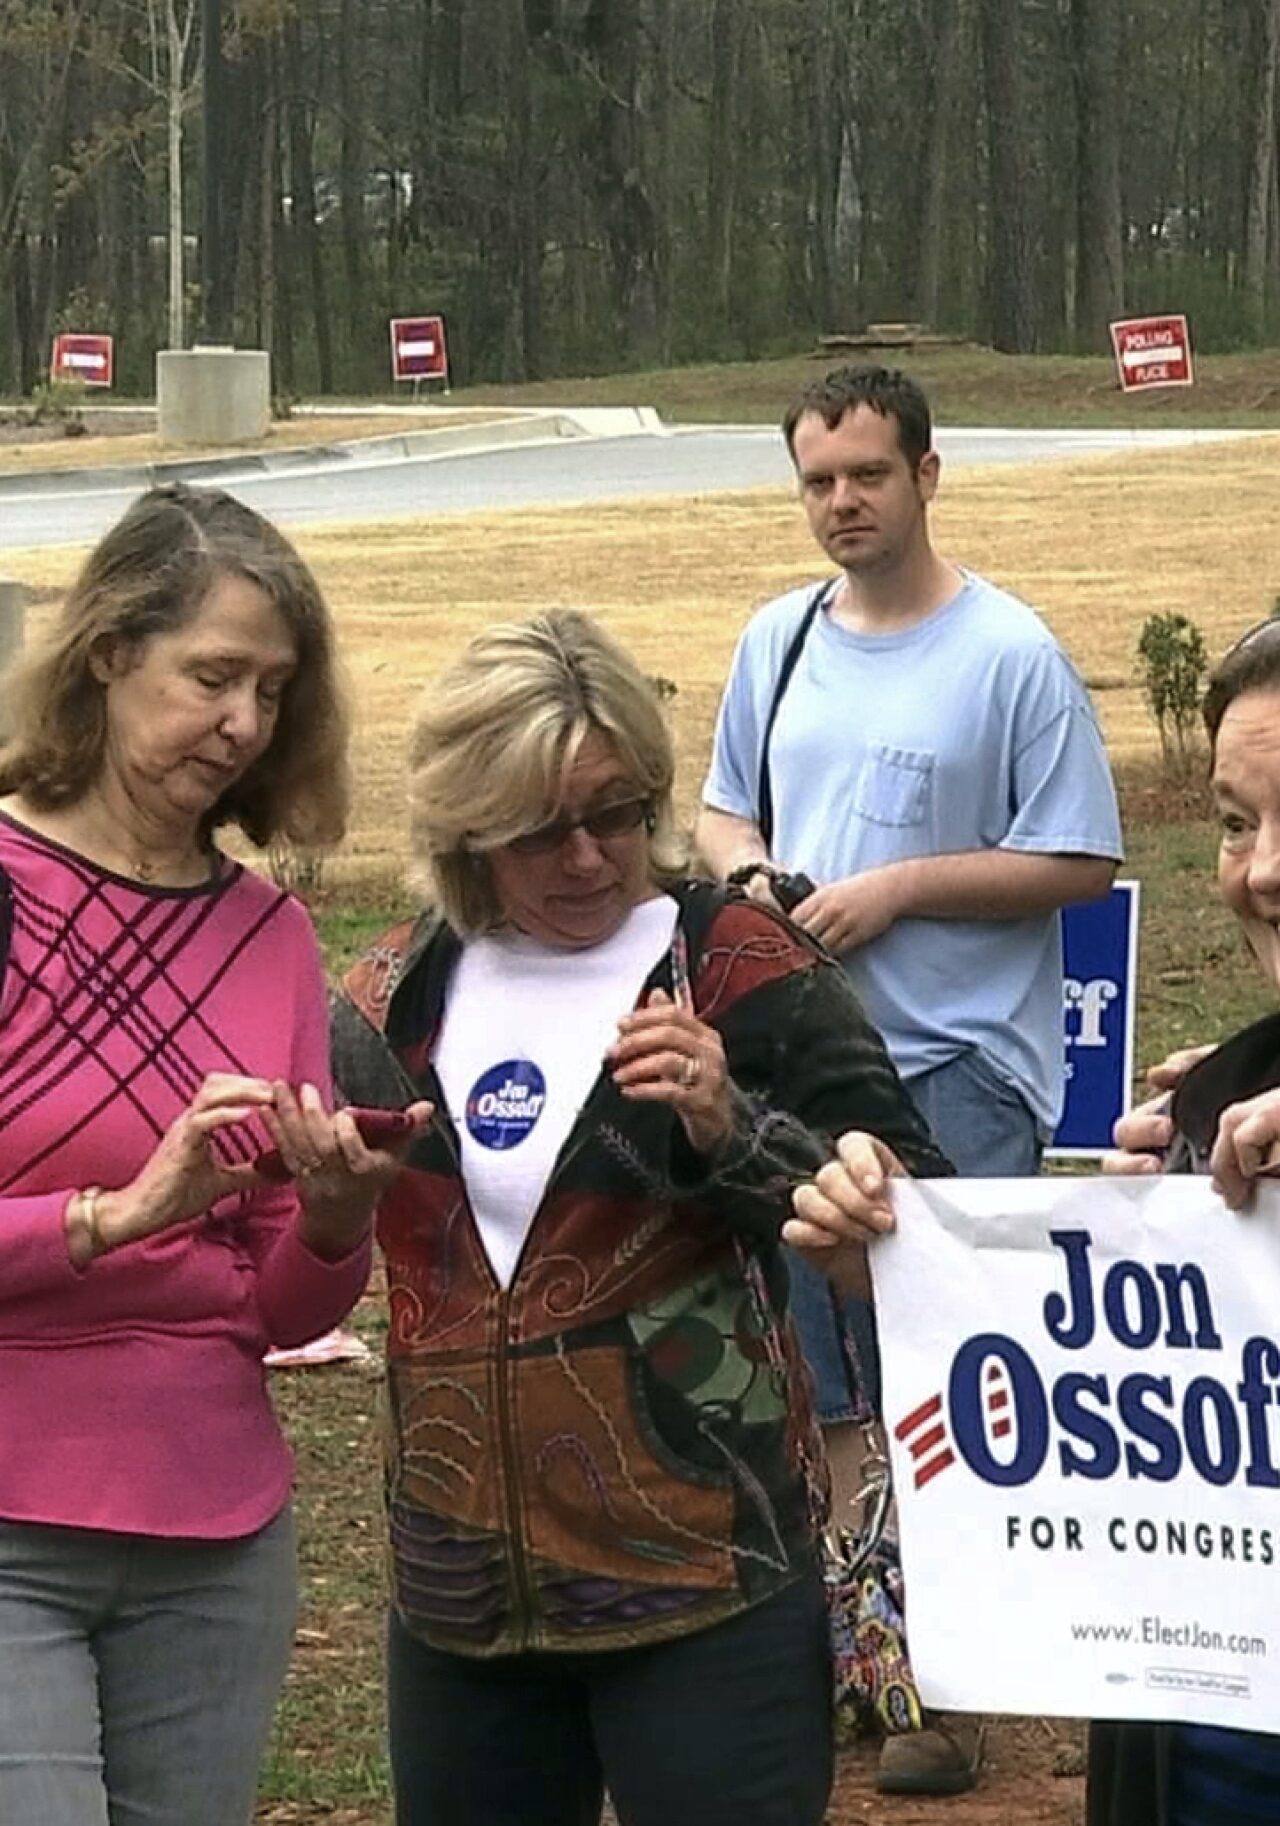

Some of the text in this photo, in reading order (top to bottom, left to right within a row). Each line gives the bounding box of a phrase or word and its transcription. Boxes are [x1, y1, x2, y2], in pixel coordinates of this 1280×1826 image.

[1043, 1229, 1222, 1350] Jon
[1006, 1515, 1084, 1551] FOR
[1070, 1615, 1268, 1657] www.ElectJon.com
